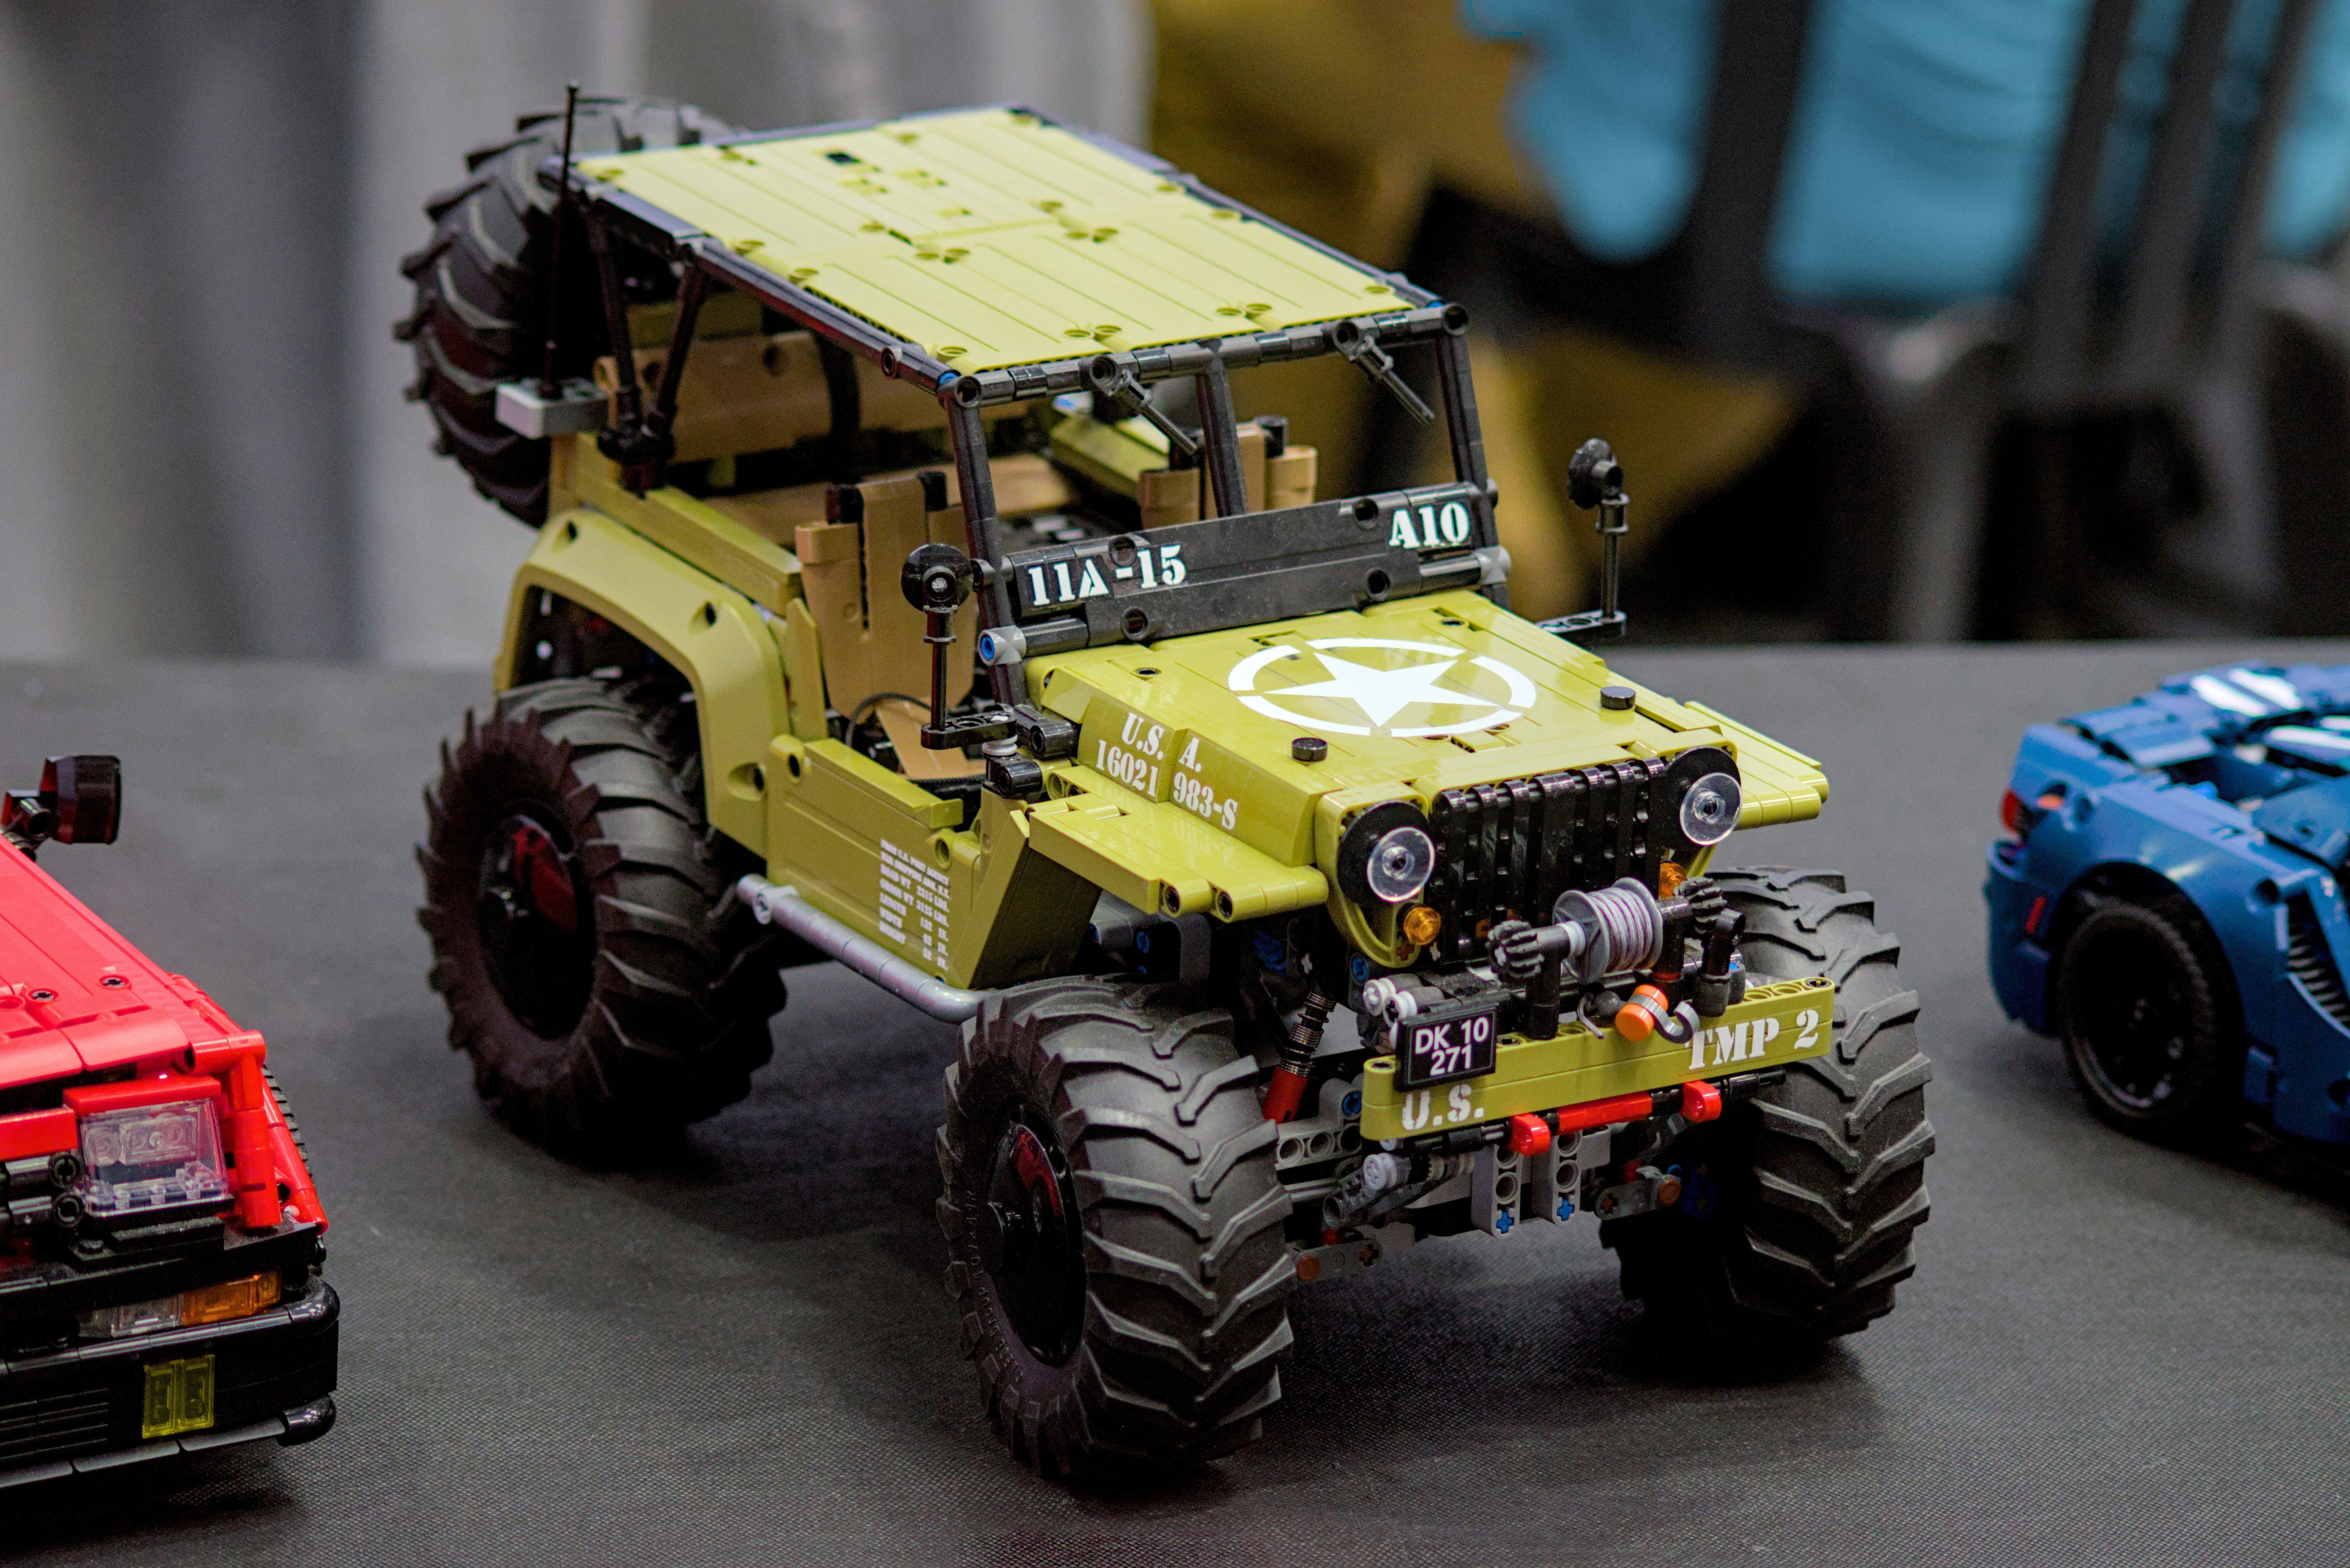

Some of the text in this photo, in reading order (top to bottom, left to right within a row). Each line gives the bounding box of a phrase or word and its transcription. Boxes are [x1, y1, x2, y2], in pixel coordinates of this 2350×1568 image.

[1389, 502, 1470, 549] A10
[1028, 544, 1187, 606] 11A-15
[1122, 712, 1201, 773] U.S. A.
[1096, 740, 1238, 830] 16021 983-S
[1415, 1017, 1489, 1055] DK 10
[1430, 1043, 1472, 1076] 271
[1686, 1009, 1819, 1070] TMP 2
[1402, 1084, 1485, 1130] U.S.
